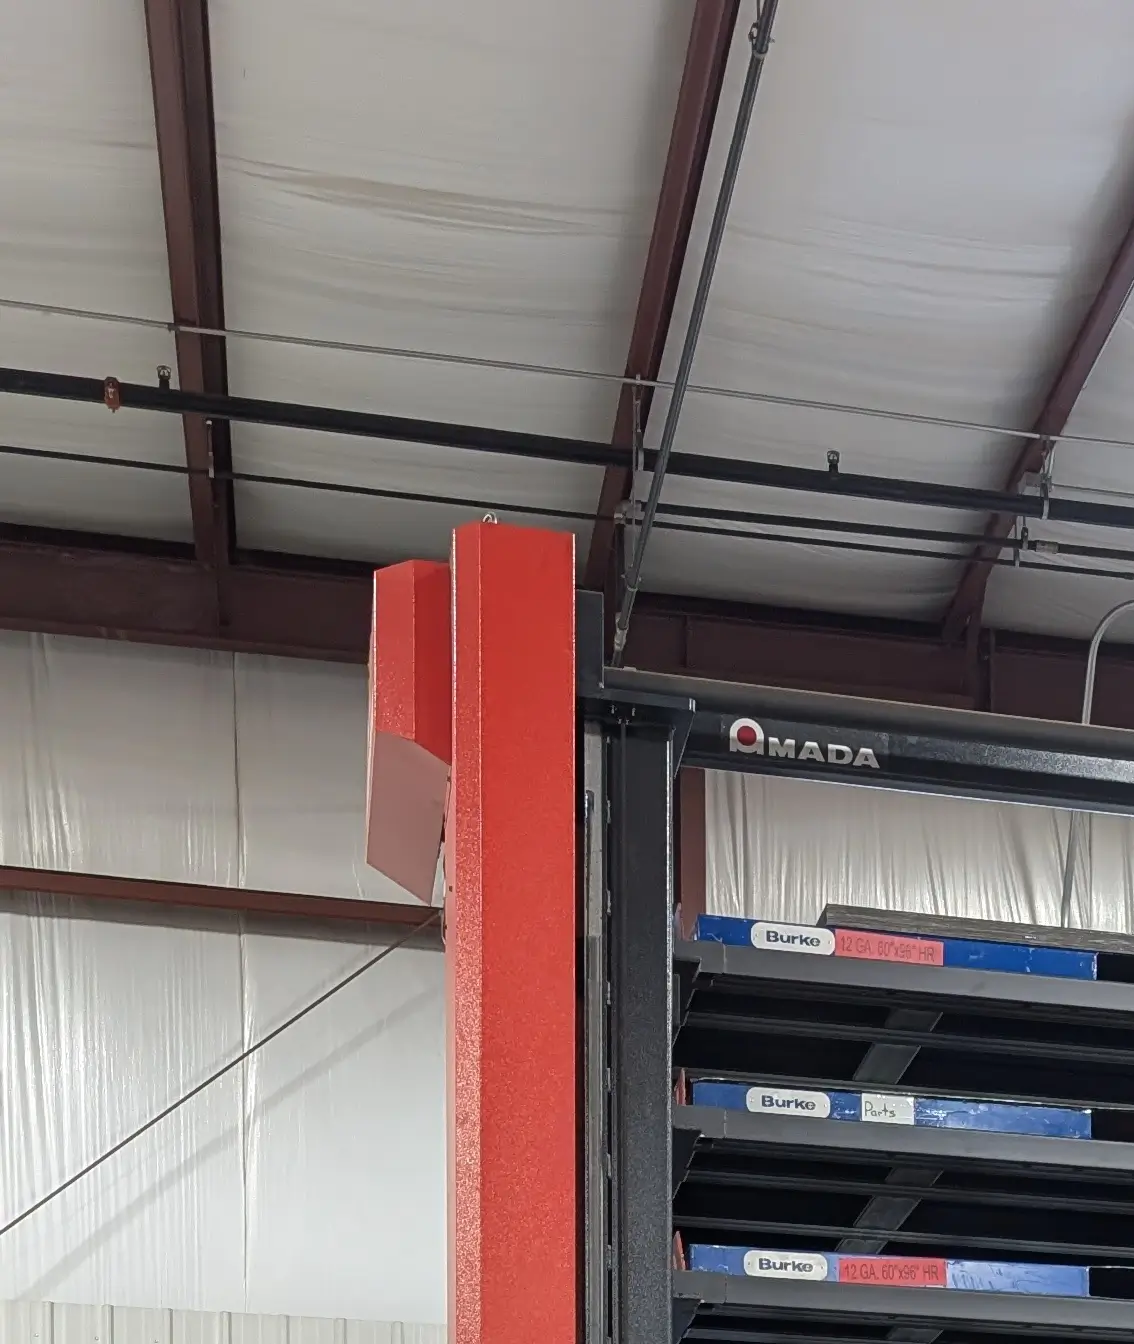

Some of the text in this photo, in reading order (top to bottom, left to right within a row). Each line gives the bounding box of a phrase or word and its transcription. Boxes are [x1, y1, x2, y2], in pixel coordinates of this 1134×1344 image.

[766, 930, 821, 948] Burke
[841, 936, 853, 952] 12
[761, 1095, 816, 1112] Burke
[863, 1100, 896, 1118] Parts
[758, 1257, 814, 1275] Burke
[845, 1263, 857, 1280] 12
[923, 1265, 939, 1281] HR
